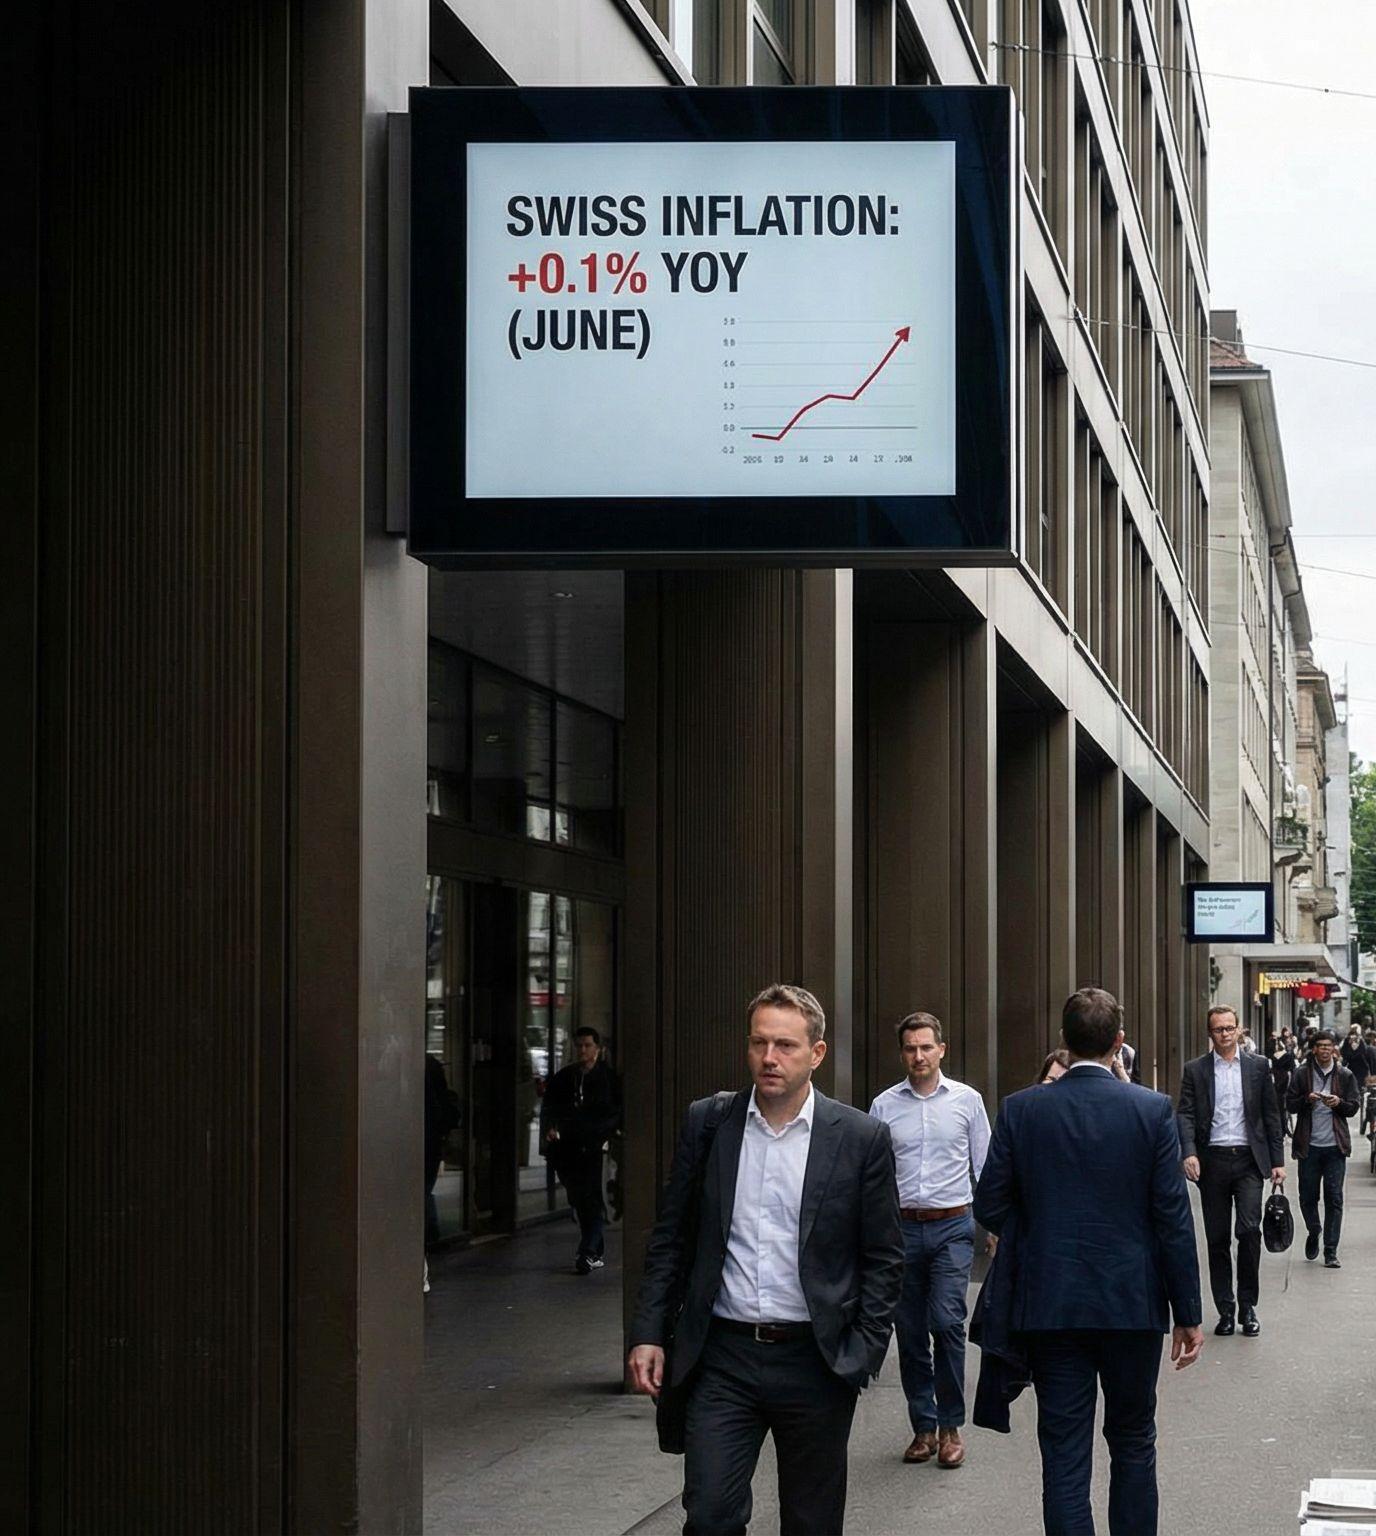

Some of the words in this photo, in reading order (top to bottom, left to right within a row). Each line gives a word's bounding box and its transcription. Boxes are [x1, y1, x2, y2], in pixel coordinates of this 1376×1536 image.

[506, 195, 647, 237] SWISS
[662, 195, 900, 236] INFLATION:
[508, 252, 648, 293] +0.1%
[661, 251, 749, 293] YOY
[508, 308, 651, 360] (JUNE)
